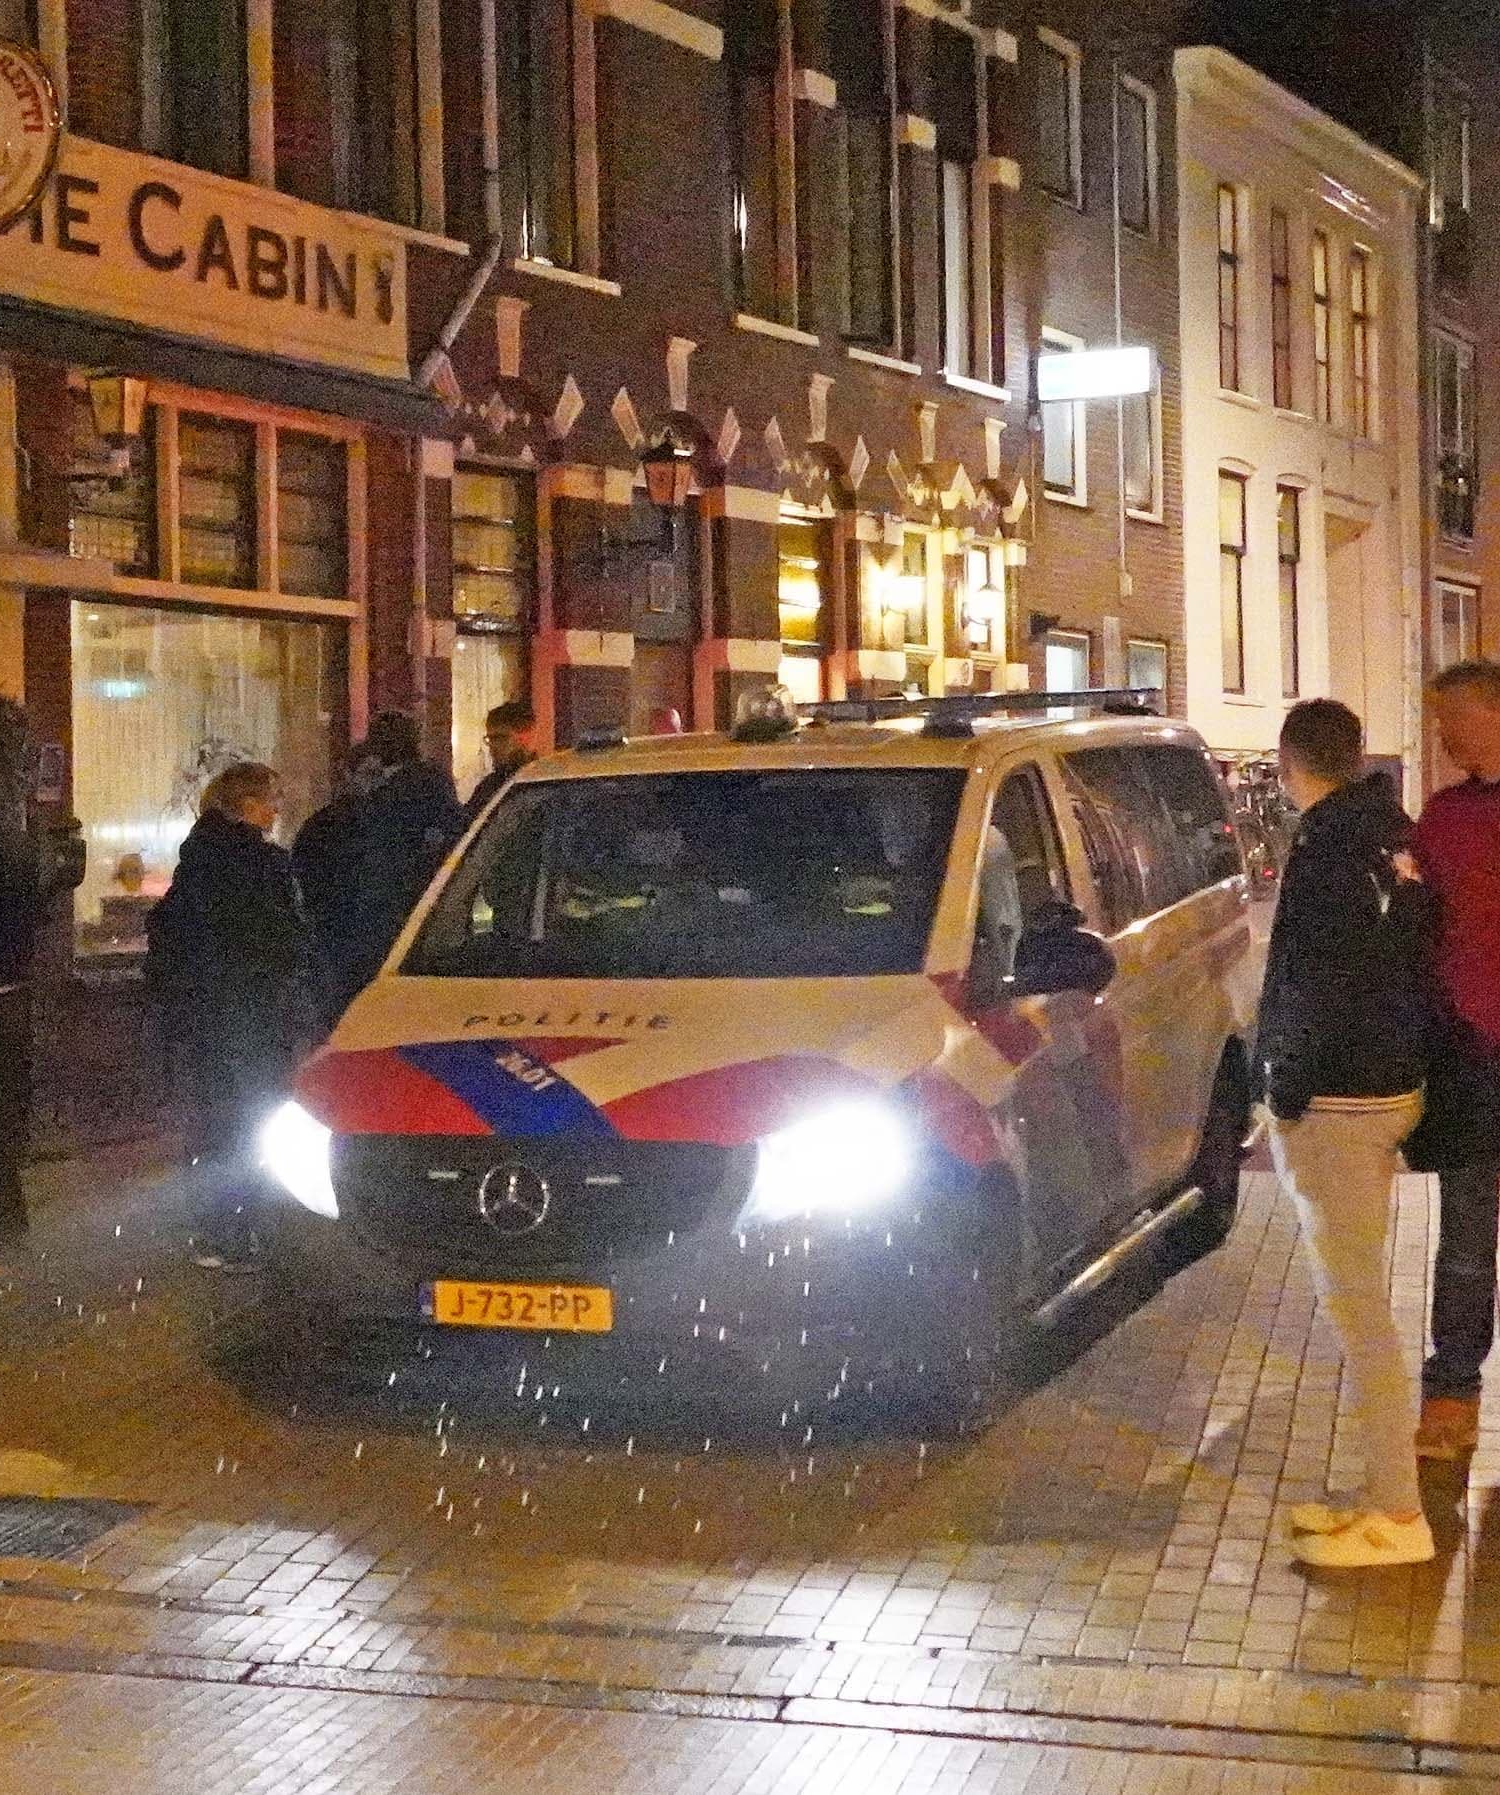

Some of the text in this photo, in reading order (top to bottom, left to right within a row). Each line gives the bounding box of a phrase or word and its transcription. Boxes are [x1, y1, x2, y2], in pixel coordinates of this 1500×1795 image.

[128, 180, 357, 319] CABIN
[463, 1012, 672, 1030] POLITIE
[451, 1287, 591, 1324] J-732-PP
